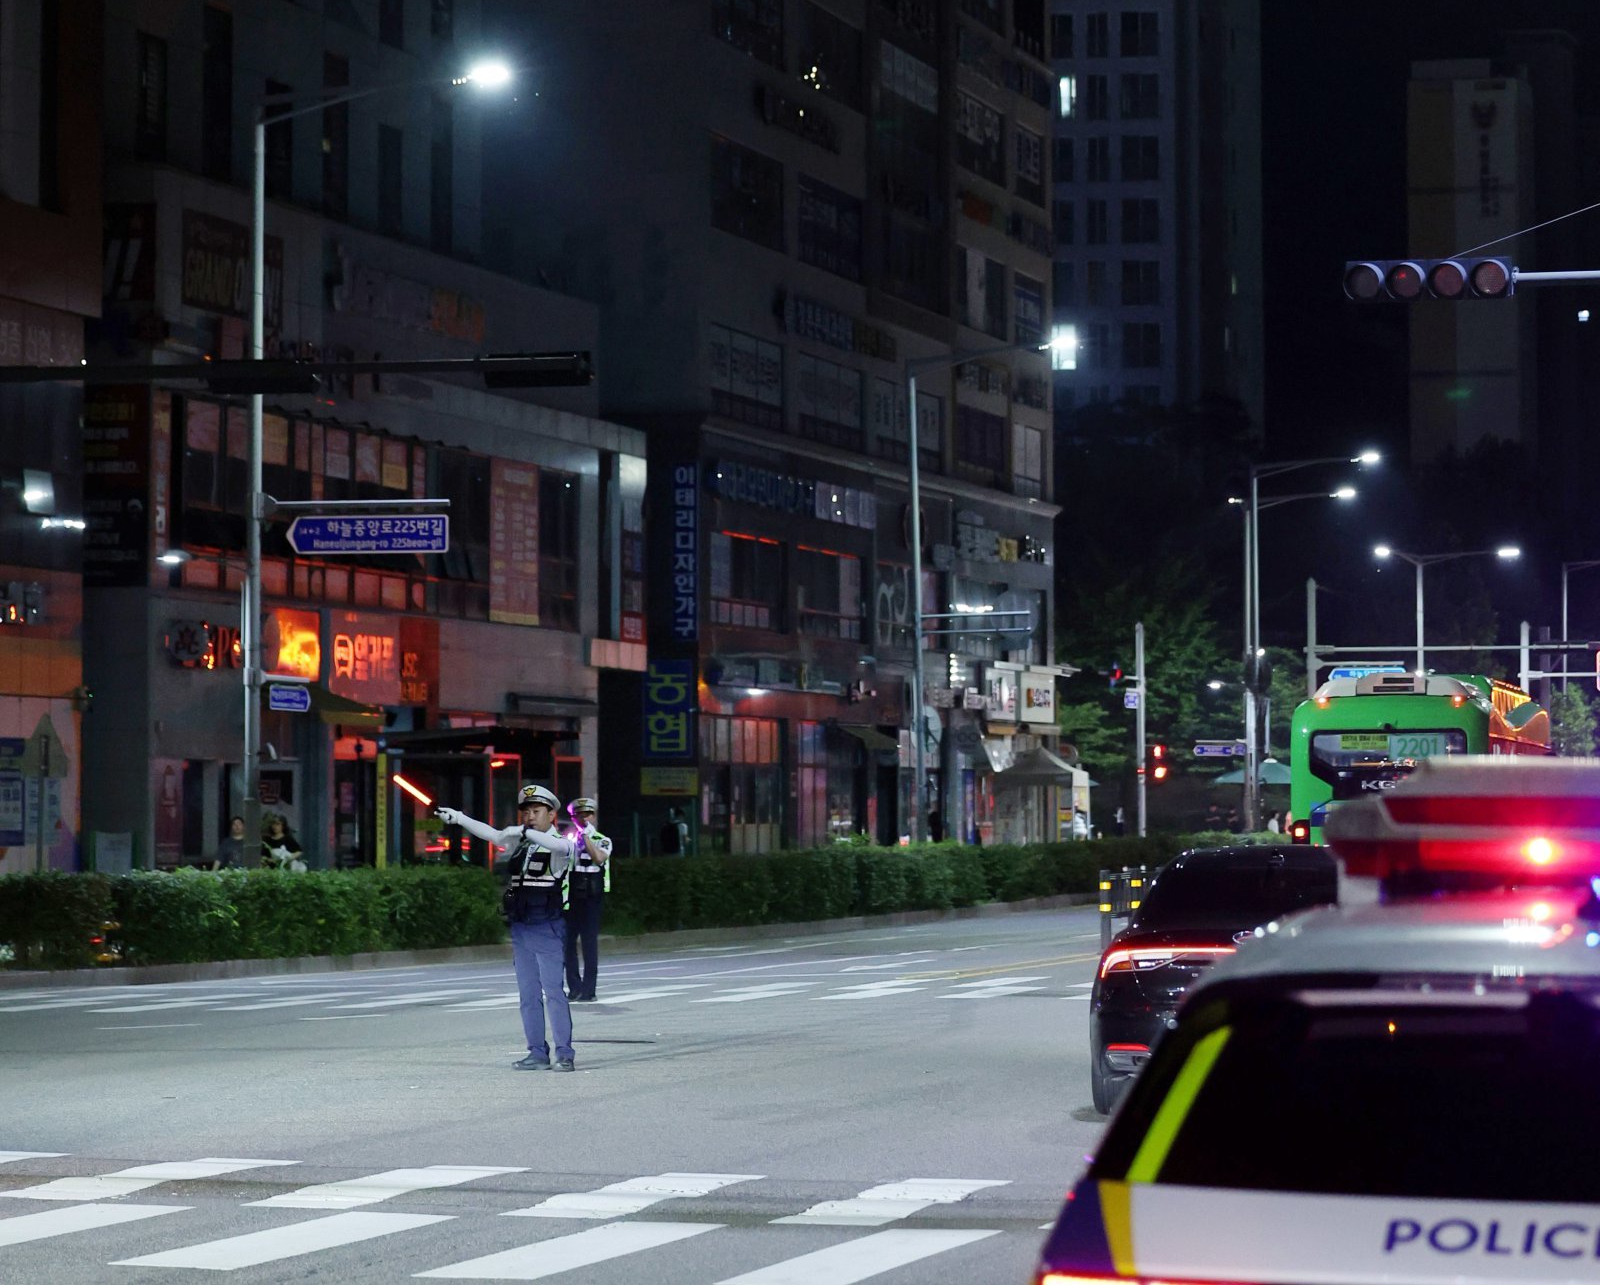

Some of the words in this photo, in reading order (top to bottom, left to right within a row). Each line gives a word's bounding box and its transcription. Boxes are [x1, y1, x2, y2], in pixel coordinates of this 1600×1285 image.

[326, 519, 444, 538] 하늘중앙로225번길
[391, 537, 443, 550] 225beon-gil
[673, 465, 696, 639] 이태리디자인가구
[646, 663, 689, 754] 농협
[1397, 737, 1438, 757] 2201
[1361, 779, 1396, 790] KG
[1383, 1217, 1600, 1260] POLIC
